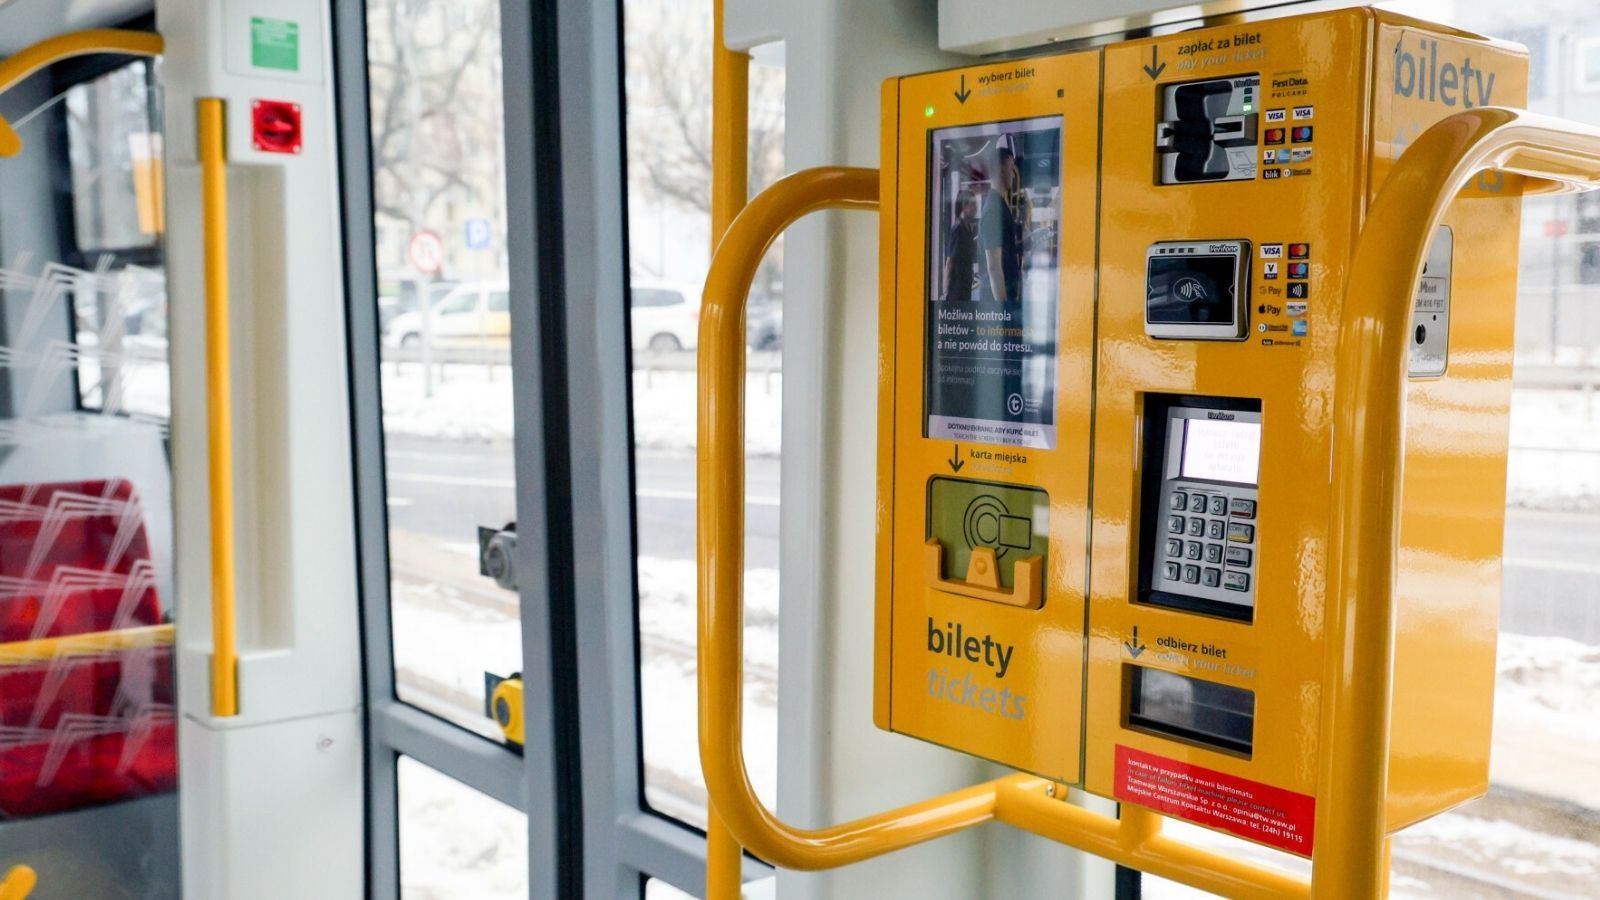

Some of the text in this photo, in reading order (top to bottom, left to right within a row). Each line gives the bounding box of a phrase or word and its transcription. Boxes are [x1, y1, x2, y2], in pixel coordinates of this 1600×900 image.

[1177, 32, 1261, 56] zapłać za bilet
[978, 68, 1035, 85] wybierz bilet
[1268, 112, 1284, 120] VISA
[1295, 108, 1311, 117] VISA
[1263, 247, 1280, 255] VISA
[938, 308, 1012, 321] Możliwa kontrola
[1267, 305, 1281, 317] Pay
[938, 324, 969, 335] biletów
[976, 327, 986, 336] to
[944, 339, 957, 350] nie
[959, 340, 989, 352] powód
[990, 340, 1002, 351] do
[1003, 342, 1033, 353] stresu.
[970, 448, 1027, 464] karta miejska
[1175, 494, 1182, 508] 1
[1193, 497, 1200, 511] 2
[1213, 499, 1221, 513] 3
[1171, 518, 1179, 529] 4
[1191, 521, 1199, 532] 5
[1211, 523, 1218, 536] 6
[1169, 541, 1177, 553] 7
[1189, 544, 1196, 557] 8
[1209, 547, 1216, 559] 9
[1186, 568, 1193, 581] 0
[927, 616, 1014, 679] bilety
[1156, 636, 1227, 659] odbierz bilet
[927, 666, 1027, 721] tickets
[1127, 758, 1152, 771] kontakt
[1160, 768, 1194, 783] przypadku
[1194, 778, 1215, 788] awarii
[1216, 782, 1254, 799] biletomatu
[1127, 775, 1157, 790] Tramwaje
[1157, 784, 1199, 801] Warszawskie
[1233, 808, 1296, 831] opinia@tw.waw.pl
[1127, 785, 1153, 798] Miejskie
[1153, 792, 1180, 806] Centrum
[1181, 799, 1212, 815] Kontaktu
[1212, 809, 1249, 826] Warszawa:
[1262, 824, 1281, 836] (24h)
[1282, 831, 1303, 843] 19115
